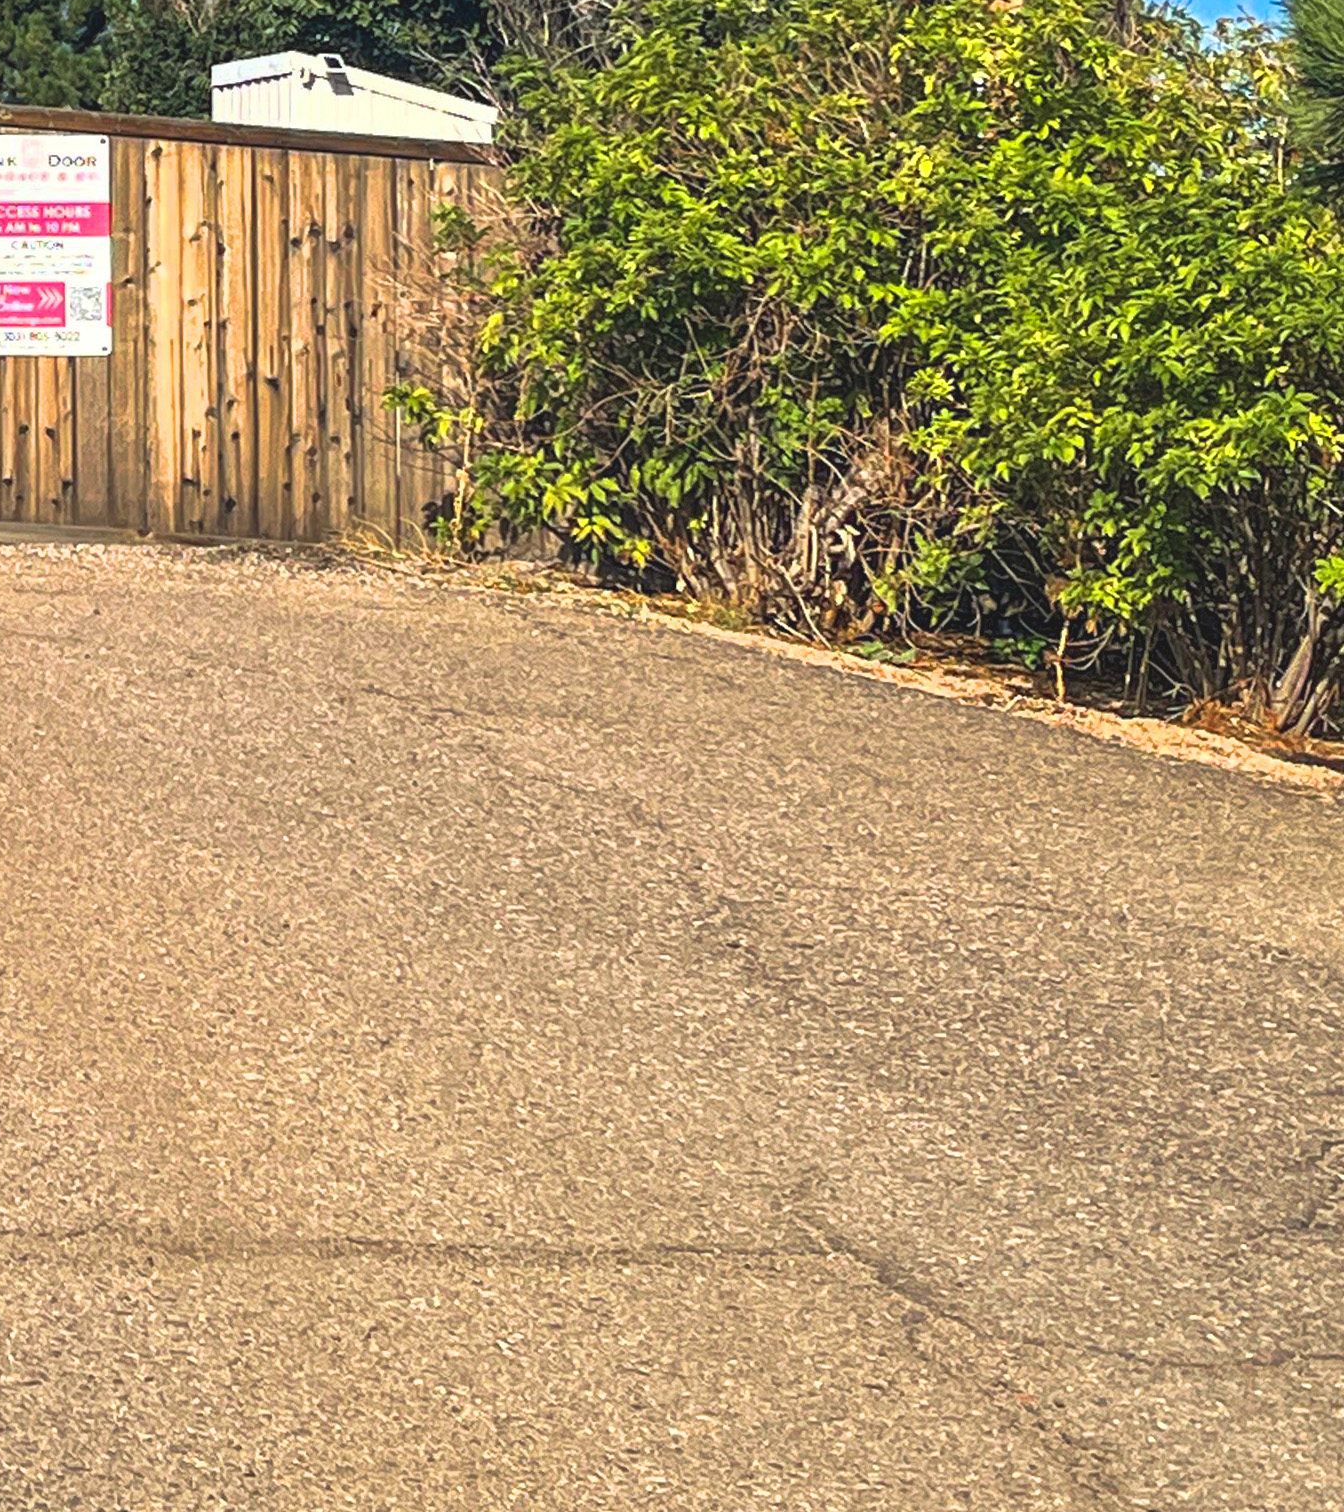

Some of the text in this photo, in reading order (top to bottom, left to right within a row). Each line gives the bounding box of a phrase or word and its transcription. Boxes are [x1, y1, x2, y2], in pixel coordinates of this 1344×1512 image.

[48, 154, 98, 167] DOOR
[43, 205, 92, 219] HOURS
[5, 222, 26, 233] AM
